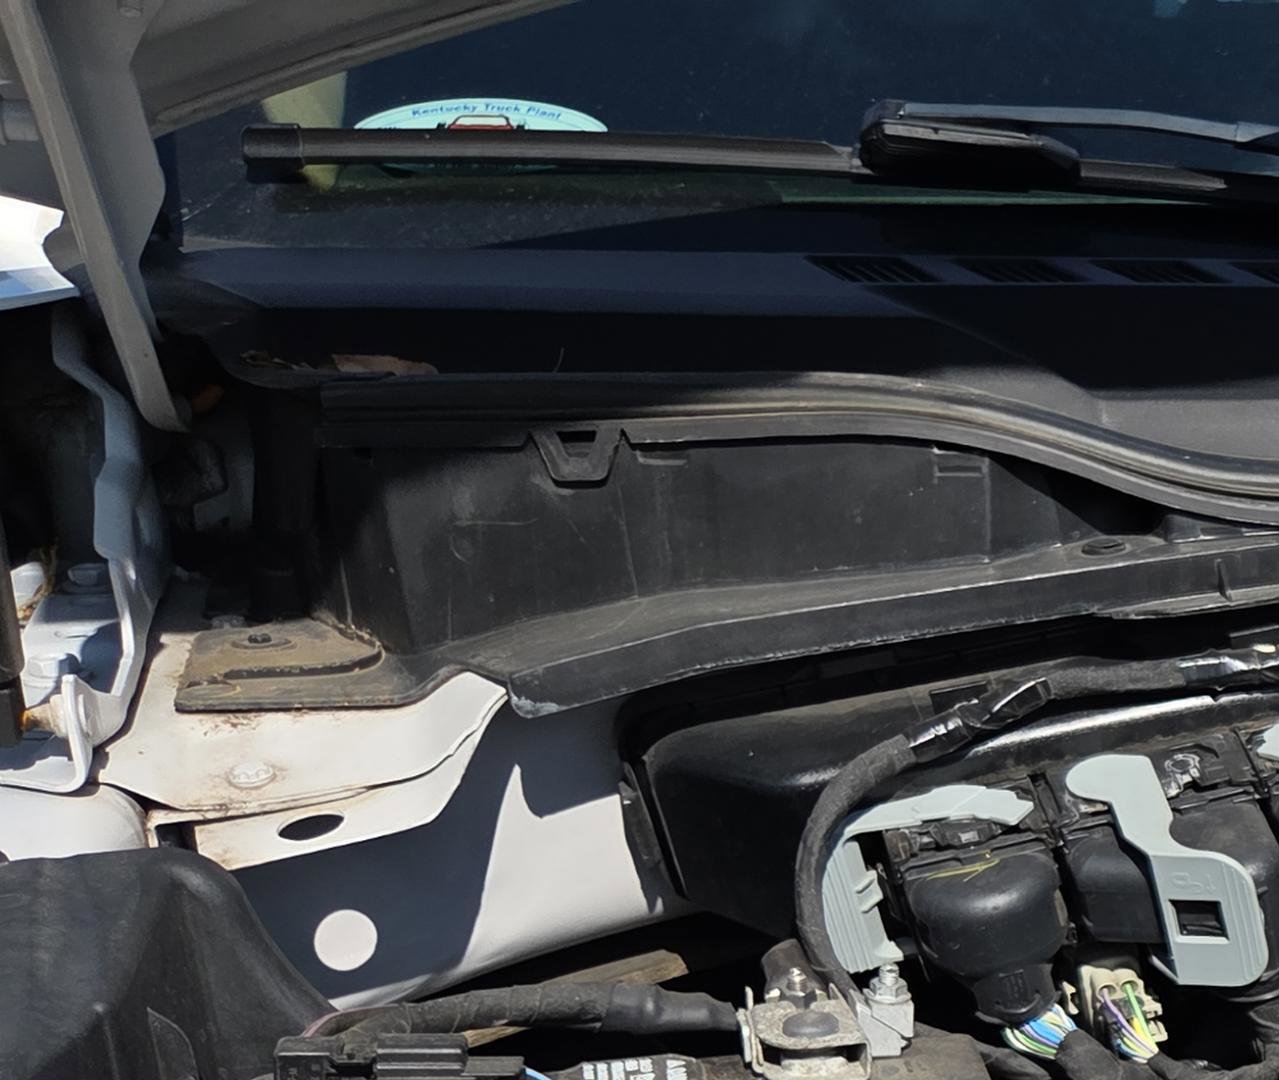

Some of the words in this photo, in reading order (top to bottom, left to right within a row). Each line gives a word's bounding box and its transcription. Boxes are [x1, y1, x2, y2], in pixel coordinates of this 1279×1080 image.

[411, 103, 478, 118] Kentucky
[483, 102, 521, 113] Truck
[526, 106, 562, 120] Plant
